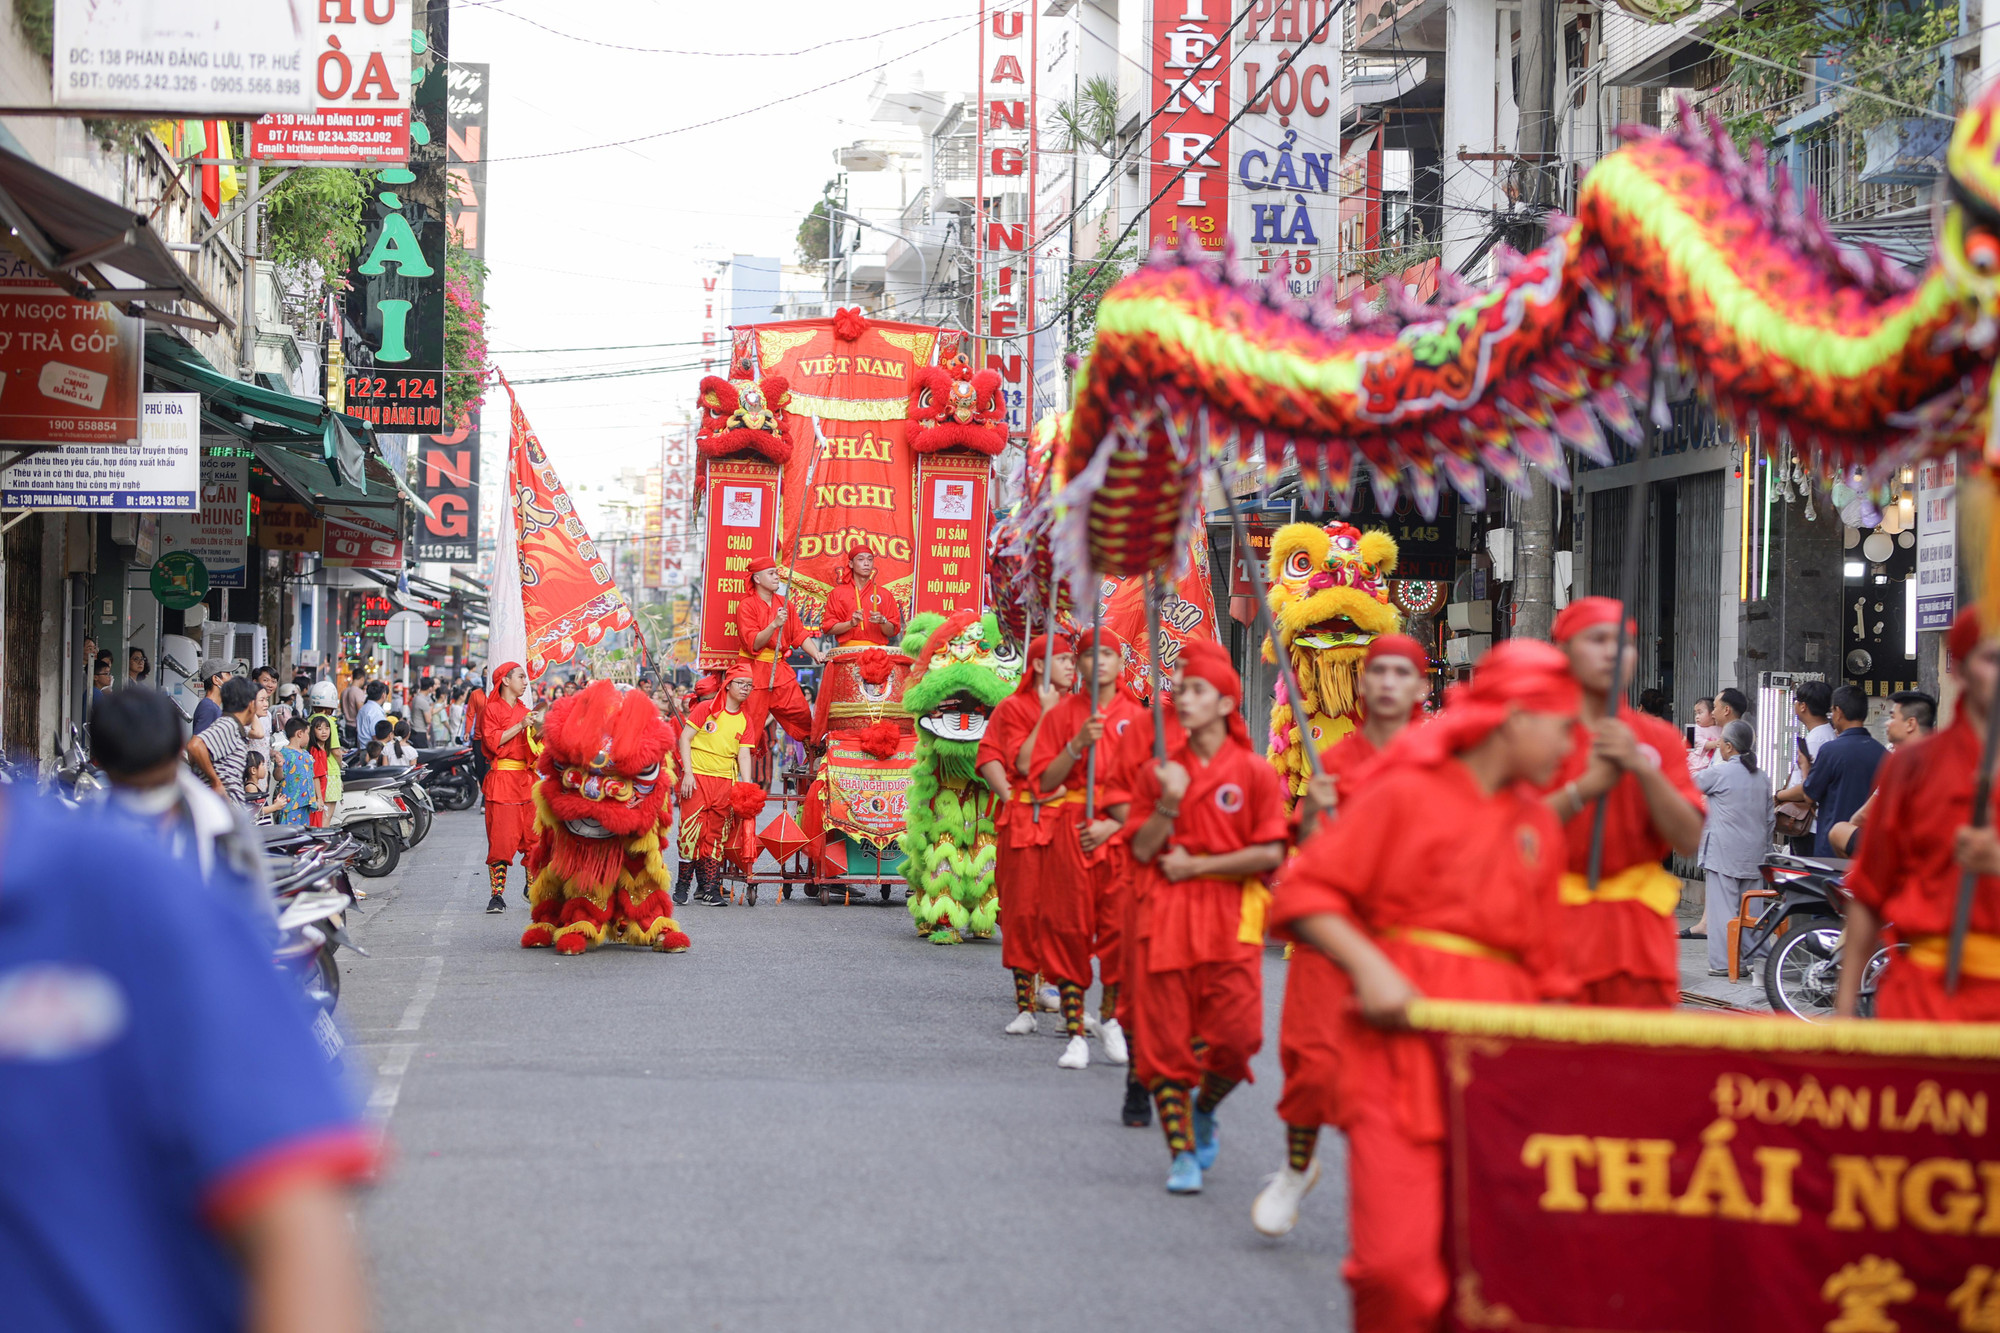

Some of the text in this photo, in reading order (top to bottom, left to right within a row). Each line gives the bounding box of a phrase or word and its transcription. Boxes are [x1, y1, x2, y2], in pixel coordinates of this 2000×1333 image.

[69, 48, 94, 65] ĐC:
[100, 48, 121, 65] 138
[126, 50, 163, 66] PHAN
[168, 49, 208, 68] ĐĂNG
[249, 52, 268, 70] TP.
[272, 48, 301, 71] HUẾ
[69, 71, 300, 95] SĐT: 0905.242.326 0905.566.898
[1244, 48, 1330, 127] LỘC
[276, 114, 294, 125] 130
[297, 115, 324, 126] PHAN
[326, 112, 353, 126] ĐĂNG
[355, 114, 375, 127] LƯU
[383, 112, 404, 127] HUẾ
[268, 130, 392, 143] ĐT/ FAX: 0234.3523.092
[257, 143, 404, 156] Email: htxtheuphuhoa@gmail.com
[1239, 129, 1333, 192] CẨN
[1251, 193, 1318, 245] HÀ
[16, 304, 66, 322] NGỌC
[19, 328, 64, 352] TRẢ
[70, 329, 119, 353] GÓP
[799, 355, 905, 379] VIỆT NAM
[64, 377, 89, 390] CMND
[346, 378, 437, 399] 122.124
[79, 391, 94, 402] LÁI
[145, 401, 183, 415] PHÚ HÒA
[382, 402, 416, 426] ĐĂNG
[417, 405, 441, 426] LƯU
[48, 420, 117, 431] 1900 558854
[66, 446, 88, 454] doanh
[91, 446, 109, 454] tranh
[130, 446, 140, 456] tay
[168, 445, 188, 456] thống
[817, 432, 894, 463] THÁI
[35, 457, 51, 466] thêu
[53, 458, 69, 466] theo
[71, 457, 84, 467] yêu
[104, 458, 117, 467] hợp
[140, 457, 155, 466] xuất
[220, 460, 236, 468] GPP
[13, 469, 31, 478] Thêu
[33, 469, 42, 478] và
[43, 469, 51, 477] in
[64, 469, 74, 478] thi
[109, 470, 125, 479] hiệu
[214, 471, 237, 480] KHÁM
[13, 480, 30, 488] Kinh
[31, 480, 54, 488] doanh
[89, 481, 108, 490] công
[123, 480, 141, 490] nghệ
[20, 494, 33, 505] 130
[33, 495, 53, 505] PHAN
[53, 493, 72, 506] ĐĂNG
[89, 495, 100, 506] TP.
[100, 492, 115, 506] HUẾ
[139, 495, 156, 506] 0234
[157, 496, 162, 506] 3
[163, 496, 176, 506] 523
[815, 483, 897, 511] NGHI
[191, 508, 244, 526] NHUNG
[274, 532, 305, 547] 124
[936, 524, 968, 541] DI SẢN
[1400, 525, 1440, 542] 145
[727, 533, 753, 550] CHÀO
[799, 527, 913, 563] ĐƯỜNG
[420, 545, 473, 559] 110 PĐL
[931, 543, 971, 558] VĂN HOÁ
[943, 561, 958, 575] VỚI
[927, 578, 971, 596] HỘI NHẬP
[943, 597, 954, 611] VÀ
[839, 776, 912, 791] THÁI NGHI ĐƯỜ
[1710, 1071, 1990, 1137] ĐOÀN LÂN
[1520, 1116, 1803, 1225] THÁI
